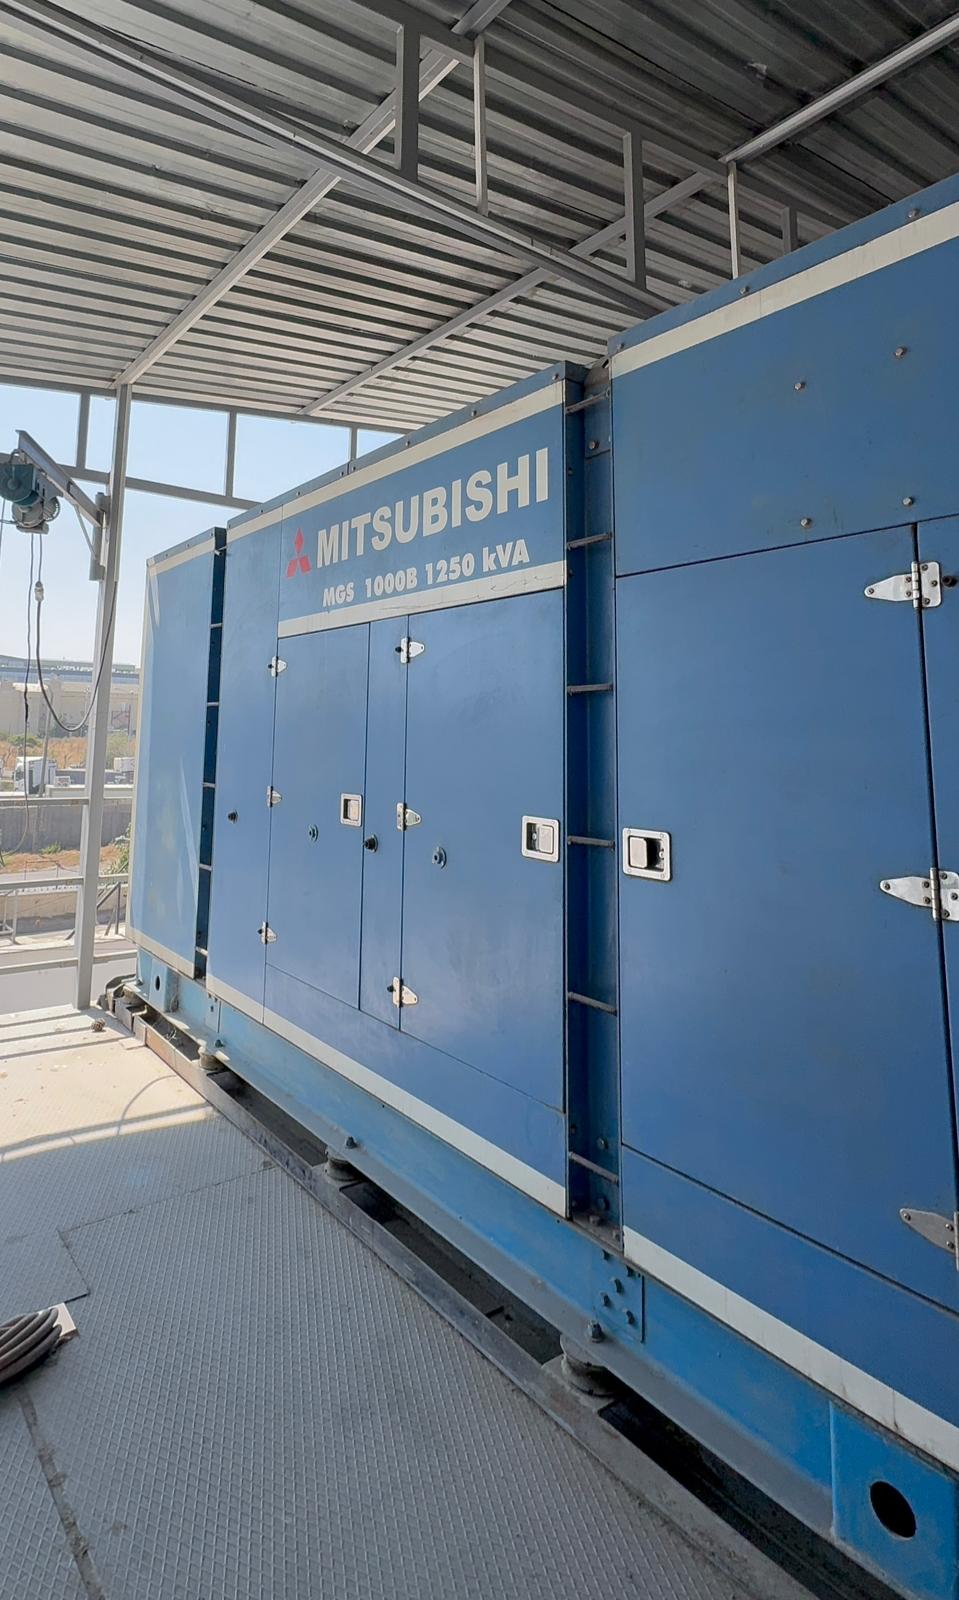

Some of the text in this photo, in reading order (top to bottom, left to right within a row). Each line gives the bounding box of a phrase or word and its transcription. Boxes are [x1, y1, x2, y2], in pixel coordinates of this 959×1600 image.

[317, 447, 549, 569] MITSUBISHI
[323, 539, 530, 608] MGS 1000B 1250 kVA
